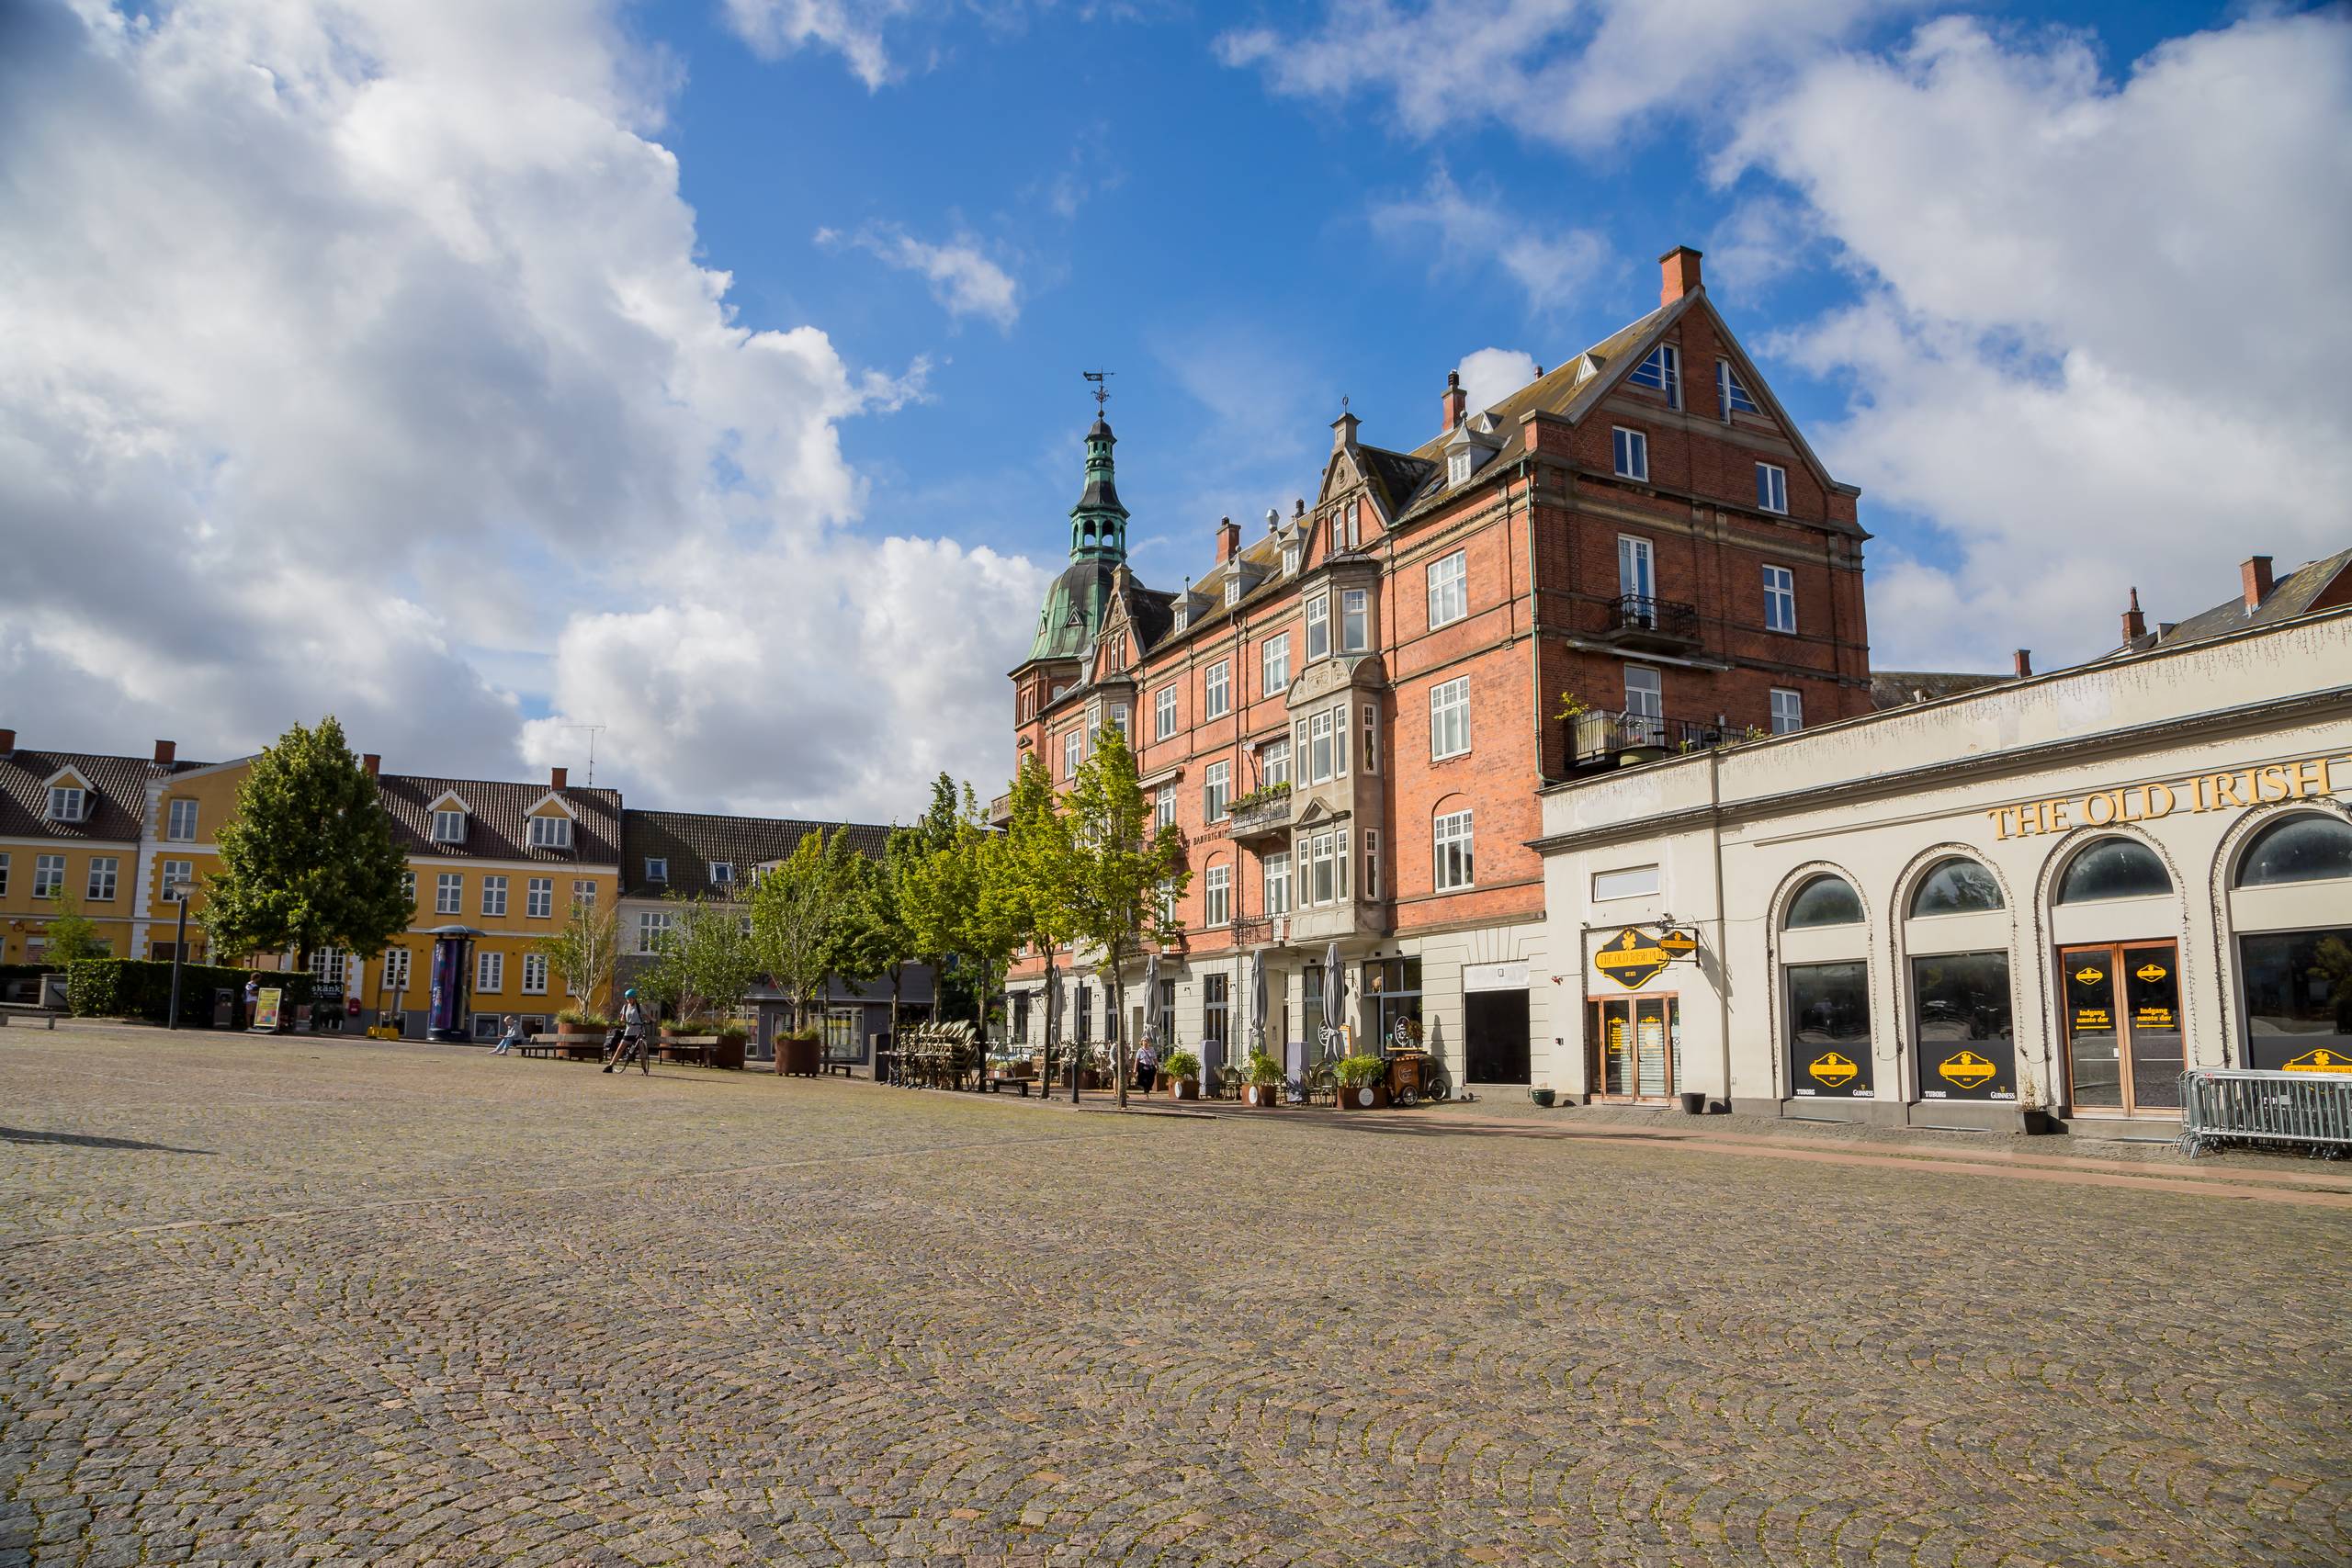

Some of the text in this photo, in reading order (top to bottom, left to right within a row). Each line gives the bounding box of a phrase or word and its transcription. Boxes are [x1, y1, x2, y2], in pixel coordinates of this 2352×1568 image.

[1986, 759, 2335, 840] THE OLD IRISH
[2140, 1007, 2168, 1015] Indgang
[1924, 1090, 1947, 1099] TUBORG
[1990, 1091, 2016, 1100] GUINNESS
